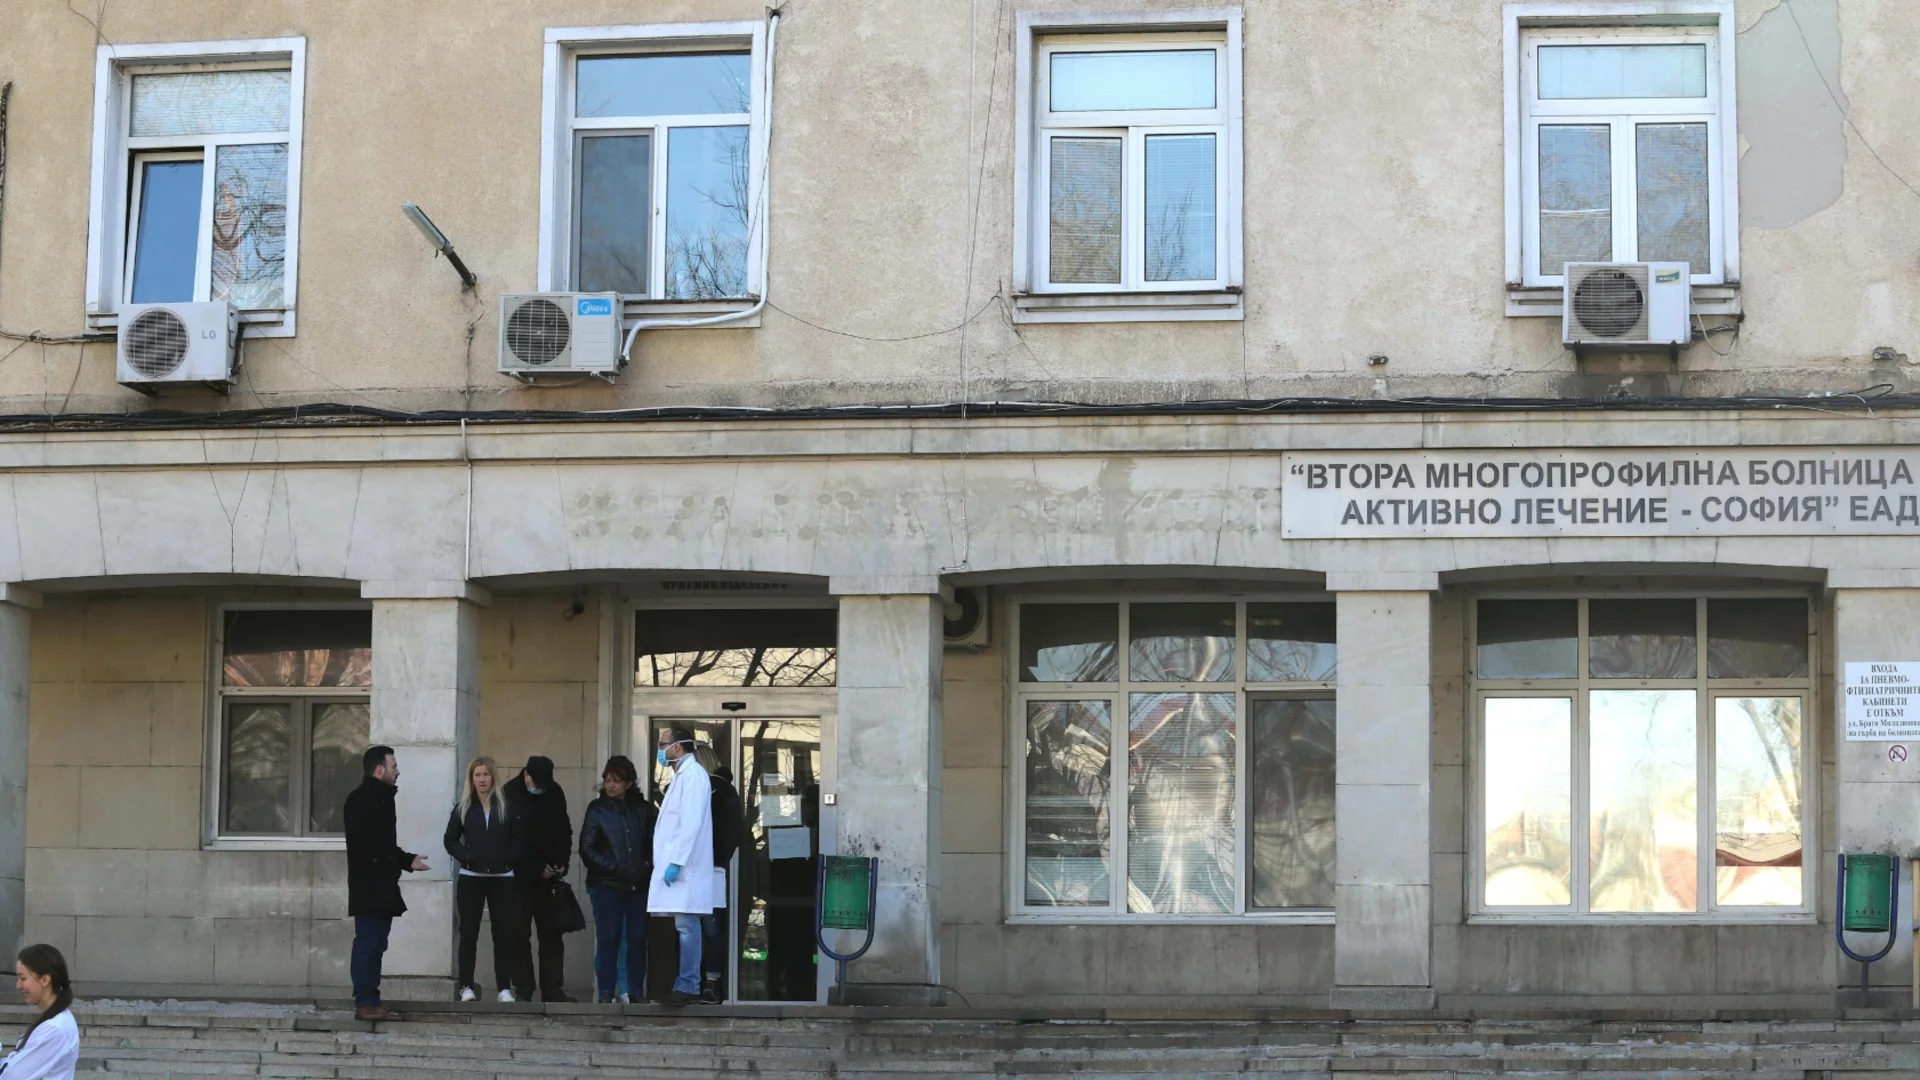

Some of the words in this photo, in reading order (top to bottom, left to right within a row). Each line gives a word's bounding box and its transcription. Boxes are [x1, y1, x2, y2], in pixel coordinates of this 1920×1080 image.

[202, 330, 217, 339] LG
[1291, 463, 1415, 489] “ВТОРА
[1426, 460, 1740, 489] МНОГОПРОФИЛНА
[1748, 459, 1914, 490] БОЛНИЦА
[1341, 498, 1502, 525] АКТИВНО
[1511, 497, 1668, 525] ЛЕЧЕНИЕ
[1701, 495, 1840, 523] СОФИЯ”
[1850, 495, 1919, 526] ЕАД
[1871, 664, 1898, 674] ВХОДА
[1860, 675, 1869, 684] ЗА
[1871, 675, 1910, 684] ПНЕВМО-
[1862, 697, 1907, 706] КАБИНЕТИ
[1866, 708, 1871, 717] Е
[1873, 708, 1904, 717] ОТКЪМ
